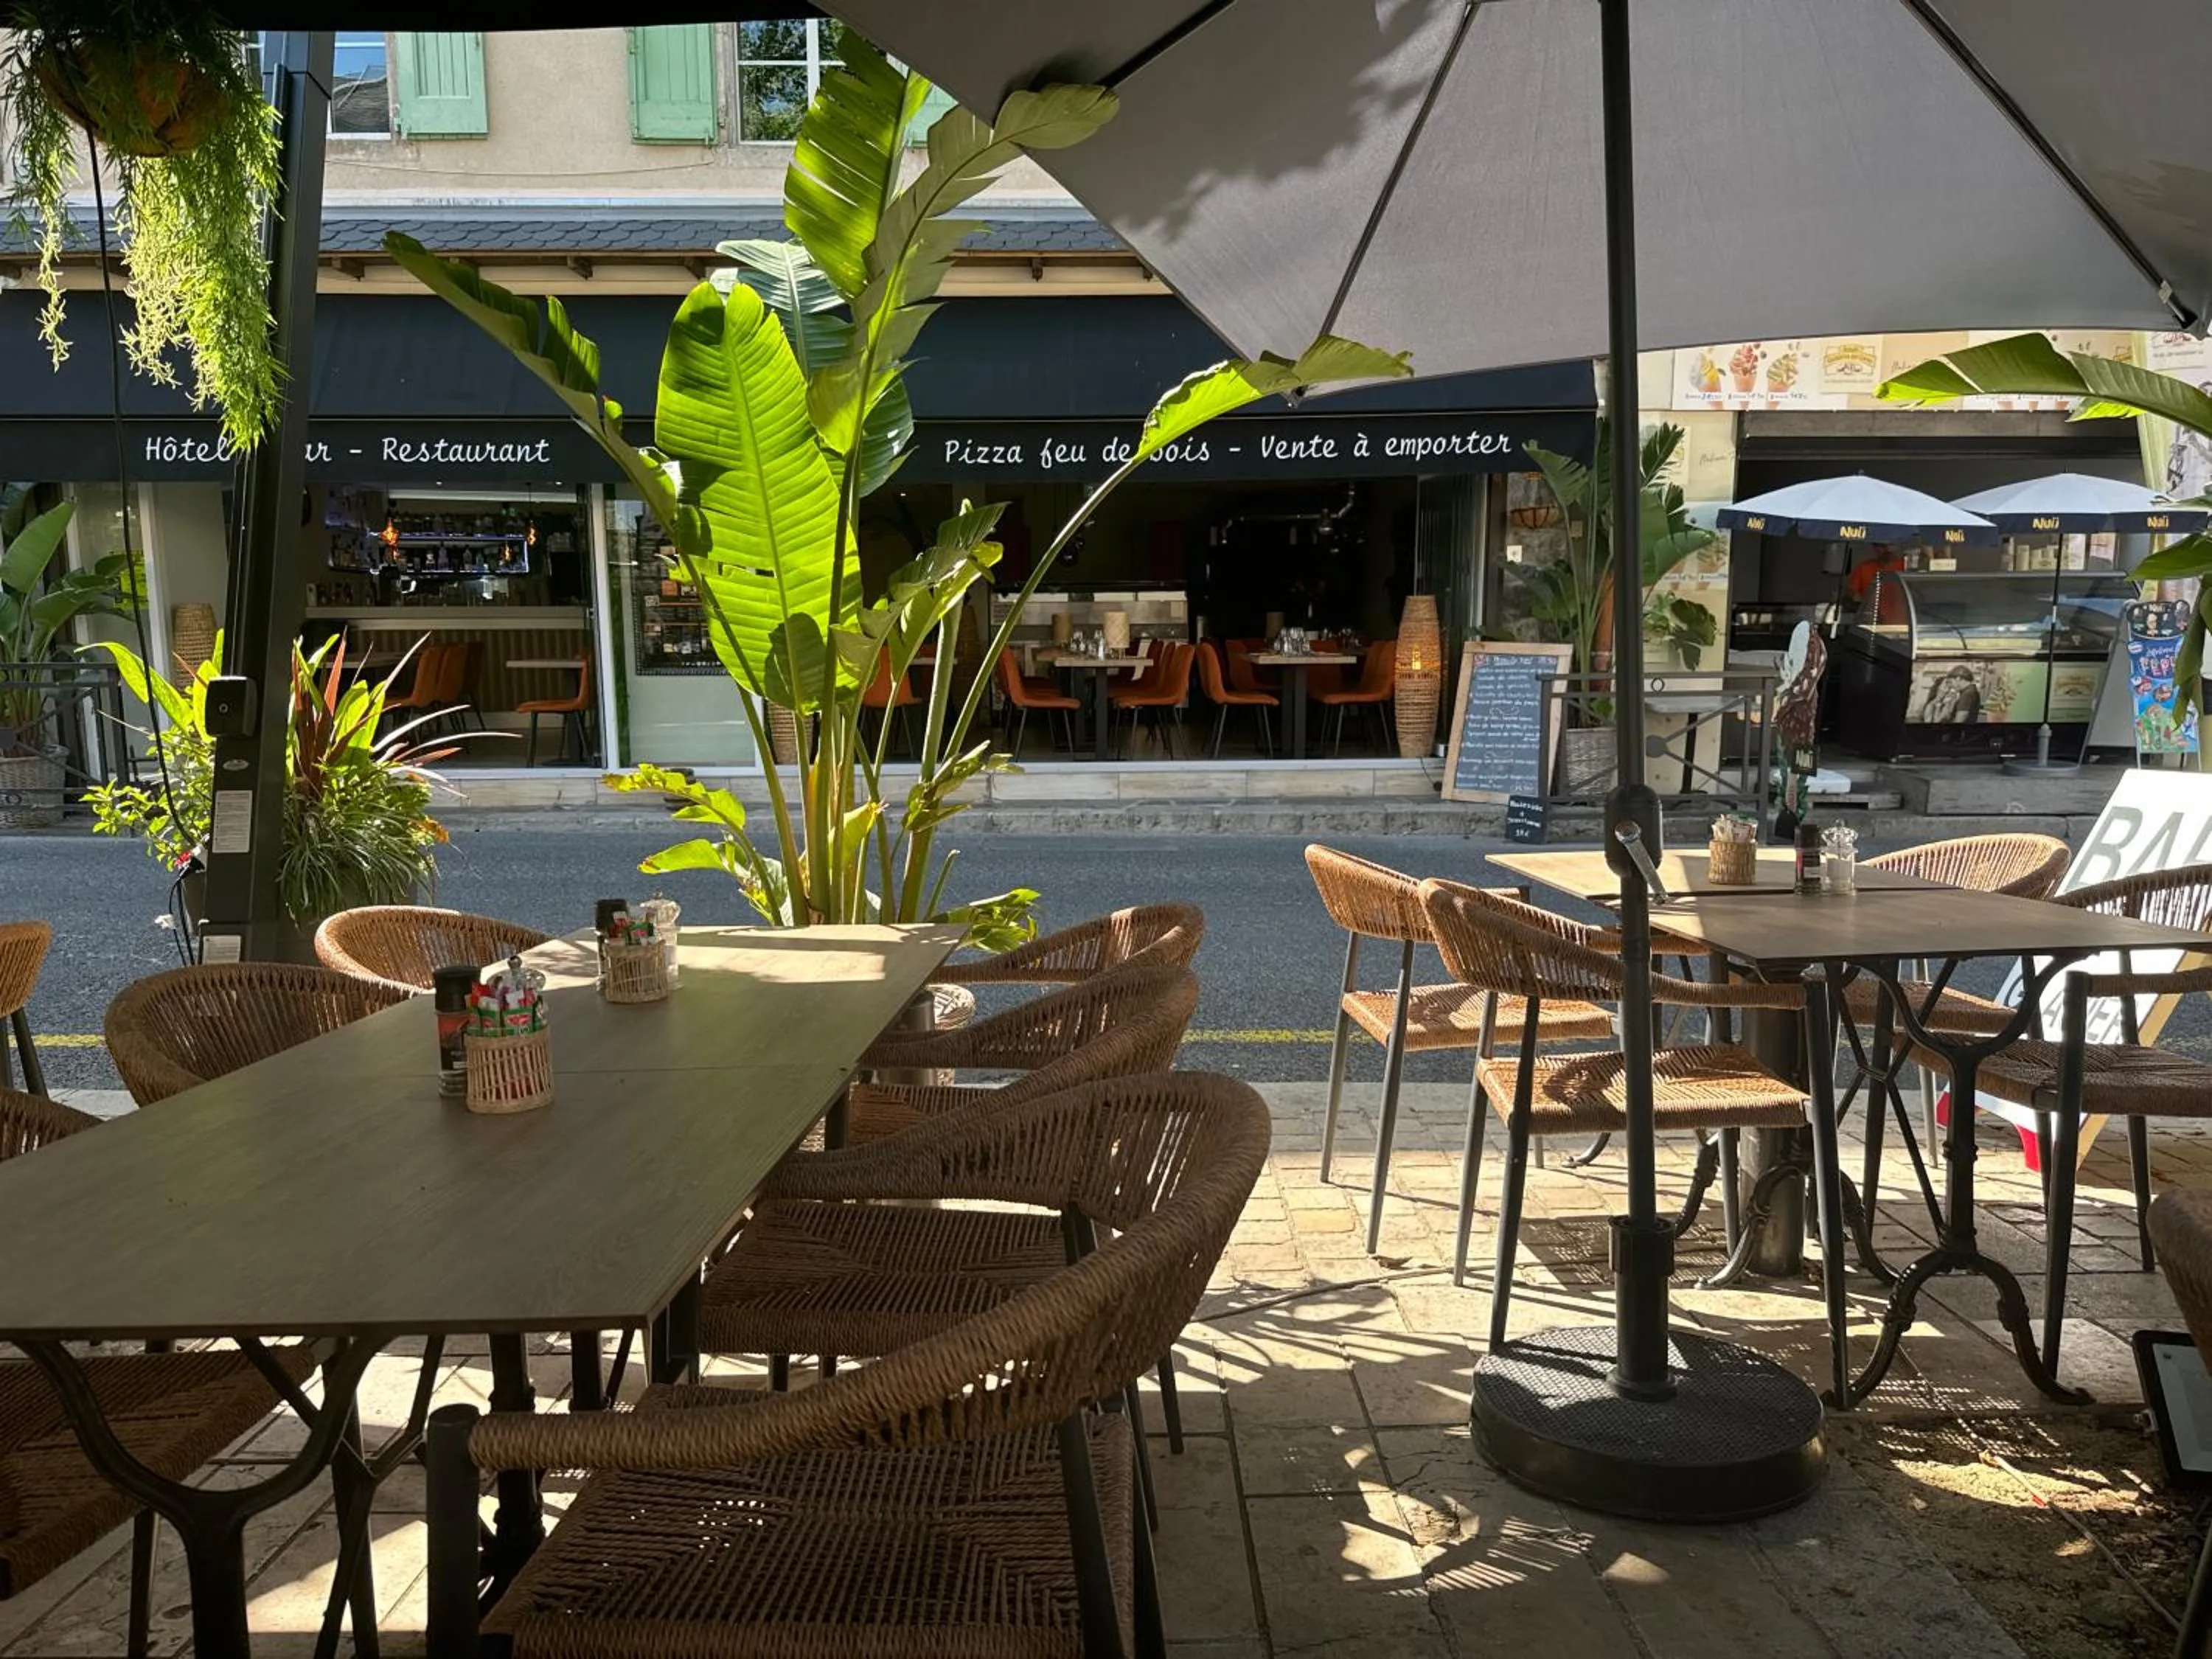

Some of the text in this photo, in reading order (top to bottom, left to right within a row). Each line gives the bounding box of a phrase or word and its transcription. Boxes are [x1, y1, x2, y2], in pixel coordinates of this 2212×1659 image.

[145, 436, 231, 462] Hôtel
[305, 442, 333, 462] ar
[381, 437, 552, 463] Restaurant
[945, 439, 1023, 465] Pizza
[1040, 437, 1087, 469] feu
[1102, 436, 1133, 462] de
[1261, 435, 1339, 460] Vente
[1353, 432, 1371, 457] à
[1385, 430, 1512, 462] emporter
[2065, 805, 2212, 891] BA
